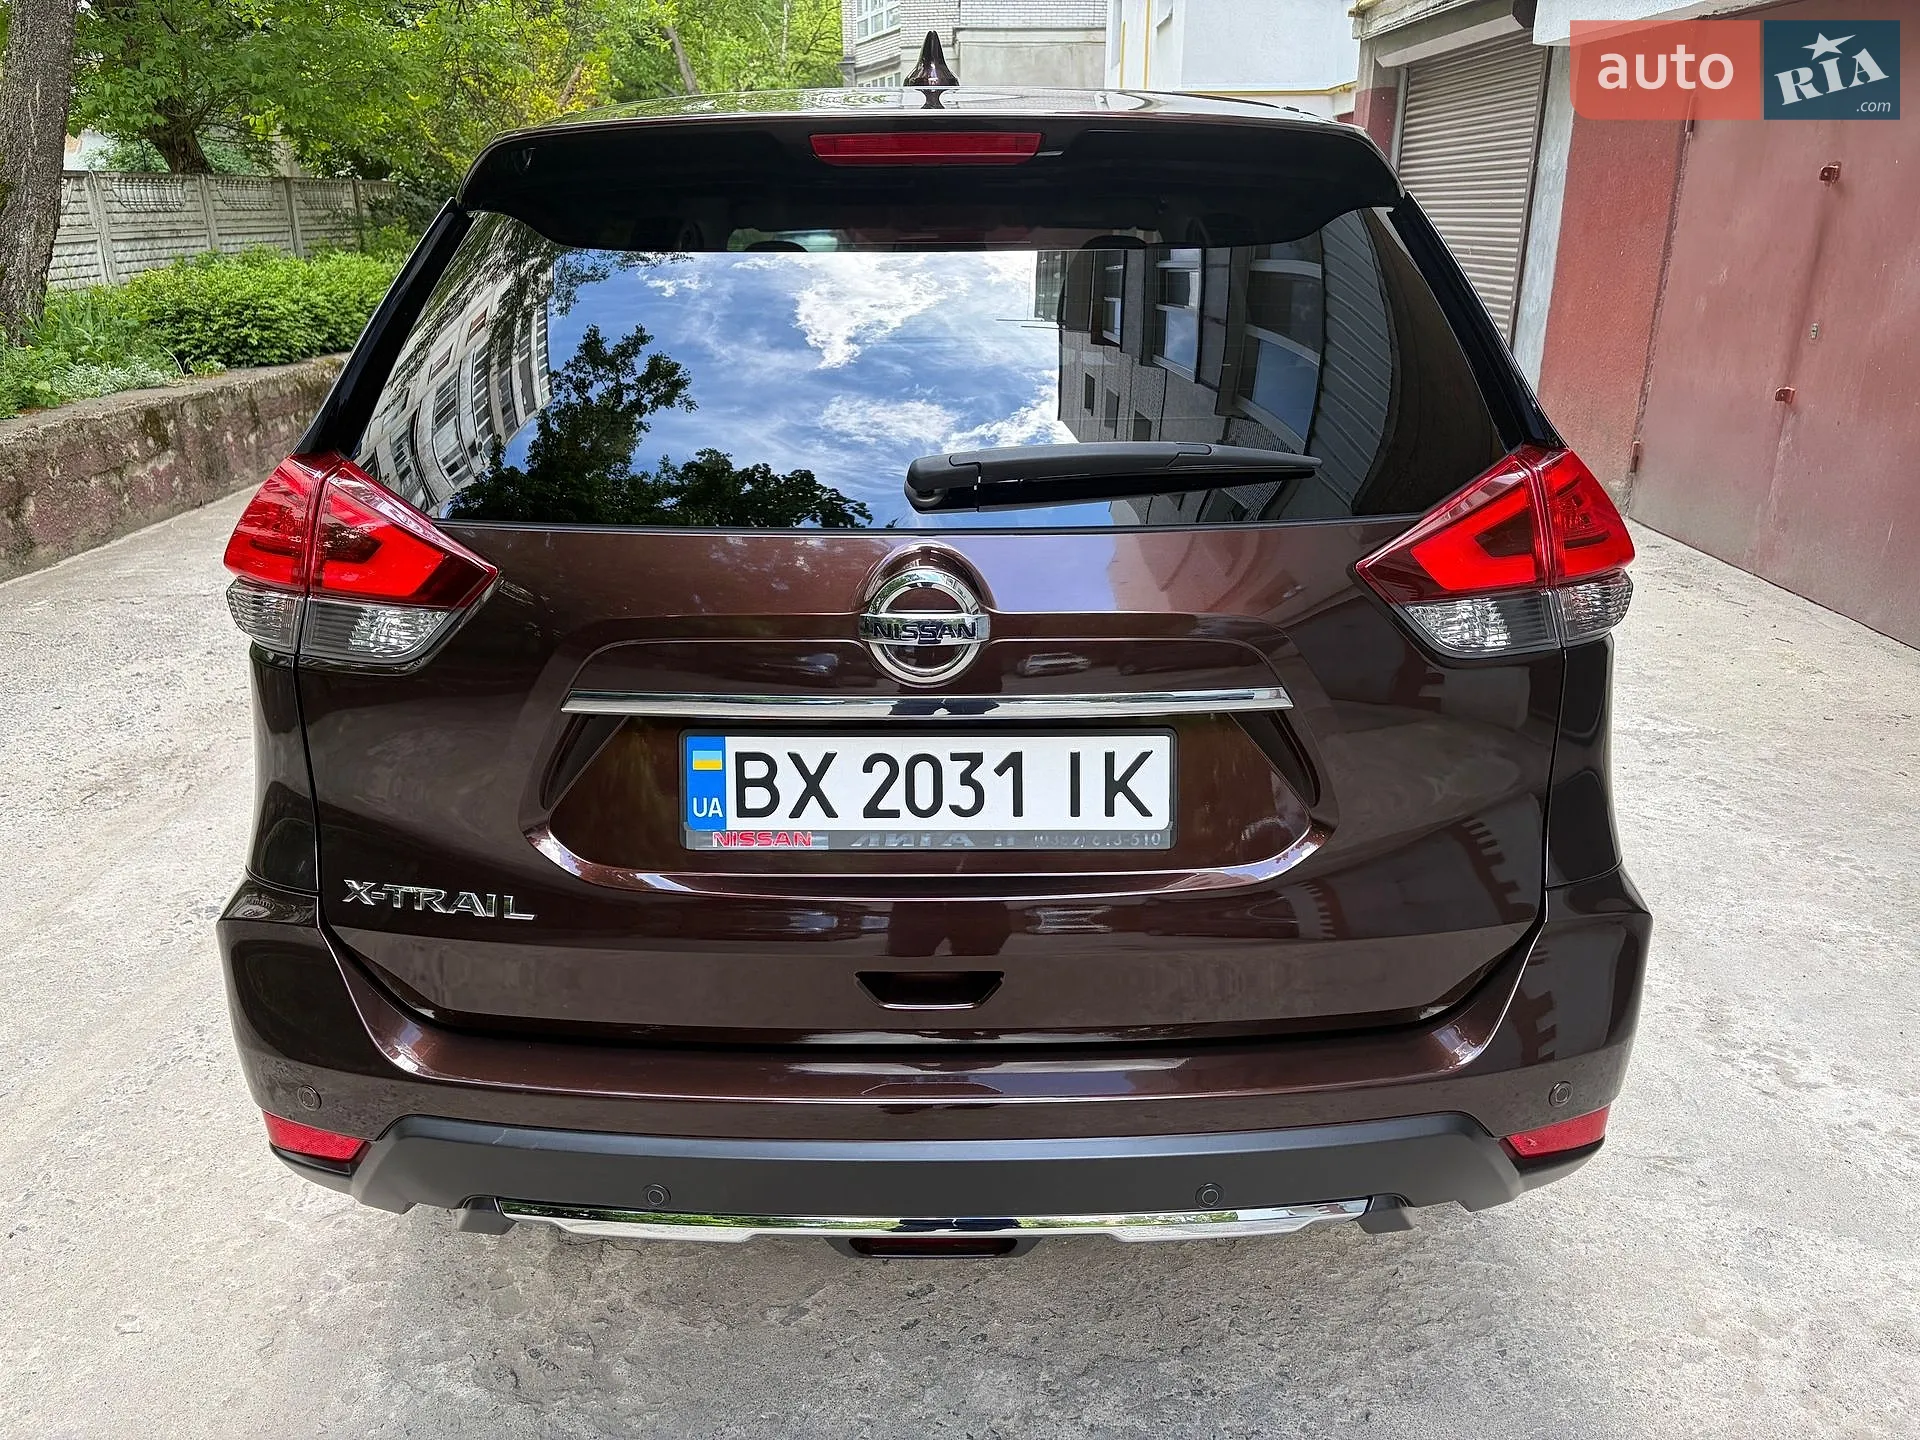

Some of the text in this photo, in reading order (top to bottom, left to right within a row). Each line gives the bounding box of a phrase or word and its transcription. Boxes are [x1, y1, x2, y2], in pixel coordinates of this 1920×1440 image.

[872, 621, 977, 641] NISSAN
[734, 749, 1154, 819] BX 2031 IK
[692, 797, 724, 818] UA
[712, 831, 812, 848] NISSAN
[341, 878, 538, 921] X-TRAIL
